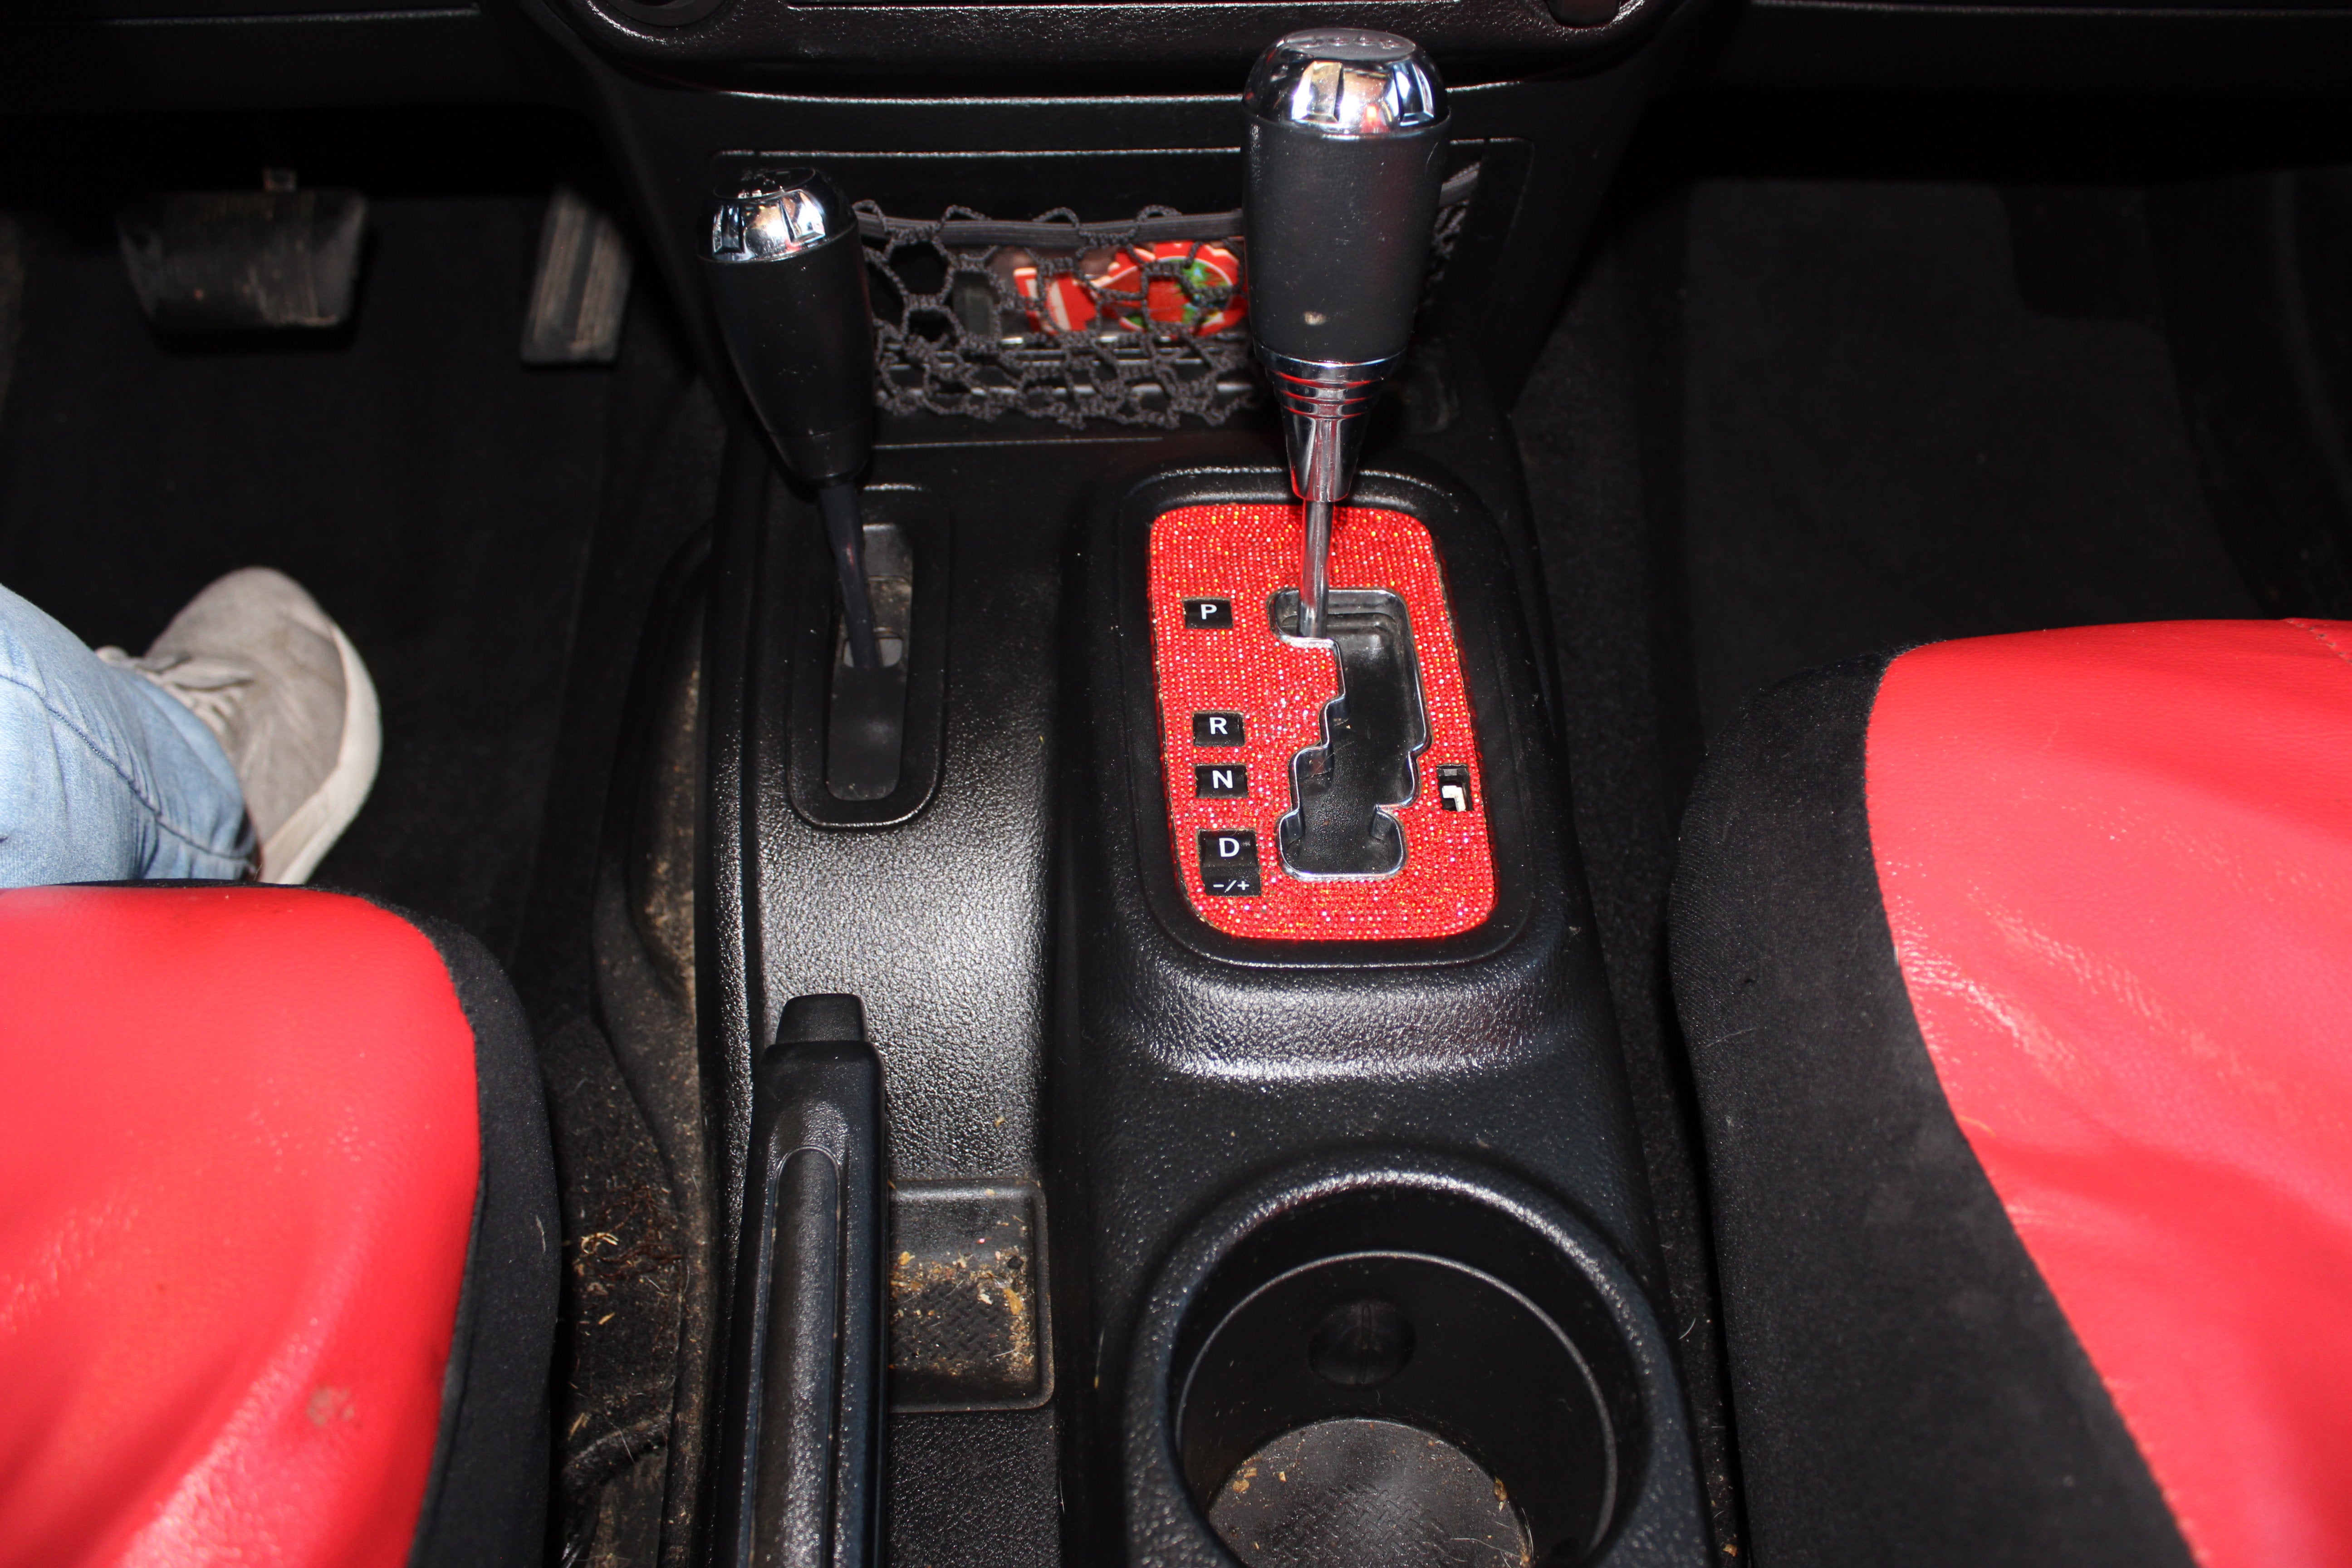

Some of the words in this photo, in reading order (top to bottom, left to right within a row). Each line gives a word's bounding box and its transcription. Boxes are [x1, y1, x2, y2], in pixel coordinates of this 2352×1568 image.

[1200, 604, 1217, 620] P
[1209, 717, 1228, 735] R
[1212, 770, 1233, 789] N
[1219, 838, 1240, 858] D
